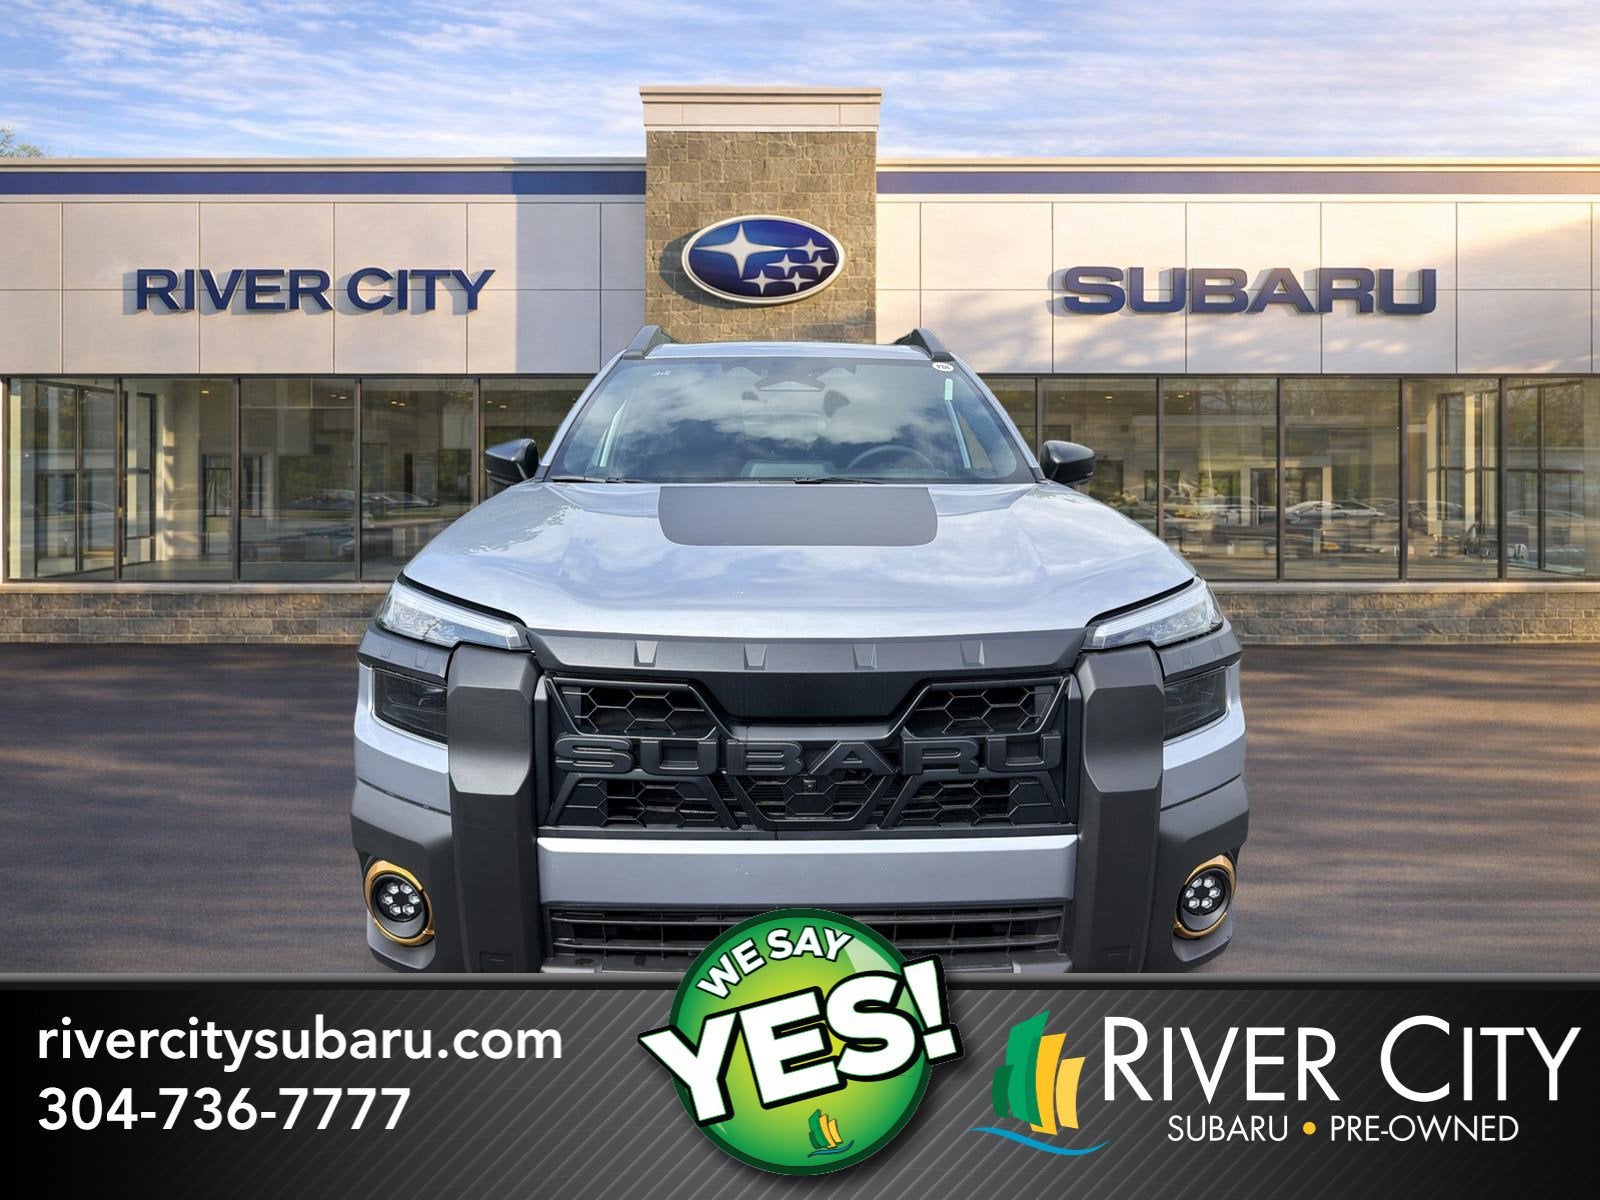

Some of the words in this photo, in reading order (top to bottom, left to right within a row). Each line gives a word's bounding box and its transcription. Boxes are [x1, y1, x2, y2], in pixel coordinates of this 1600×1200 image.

[137, 269, 332, 311] RIVER
[347, 268, 495, 311] CITY
[1063, 267, 1436, 315] SUBARU
[554, 730, 1061, 776] SUBARU
